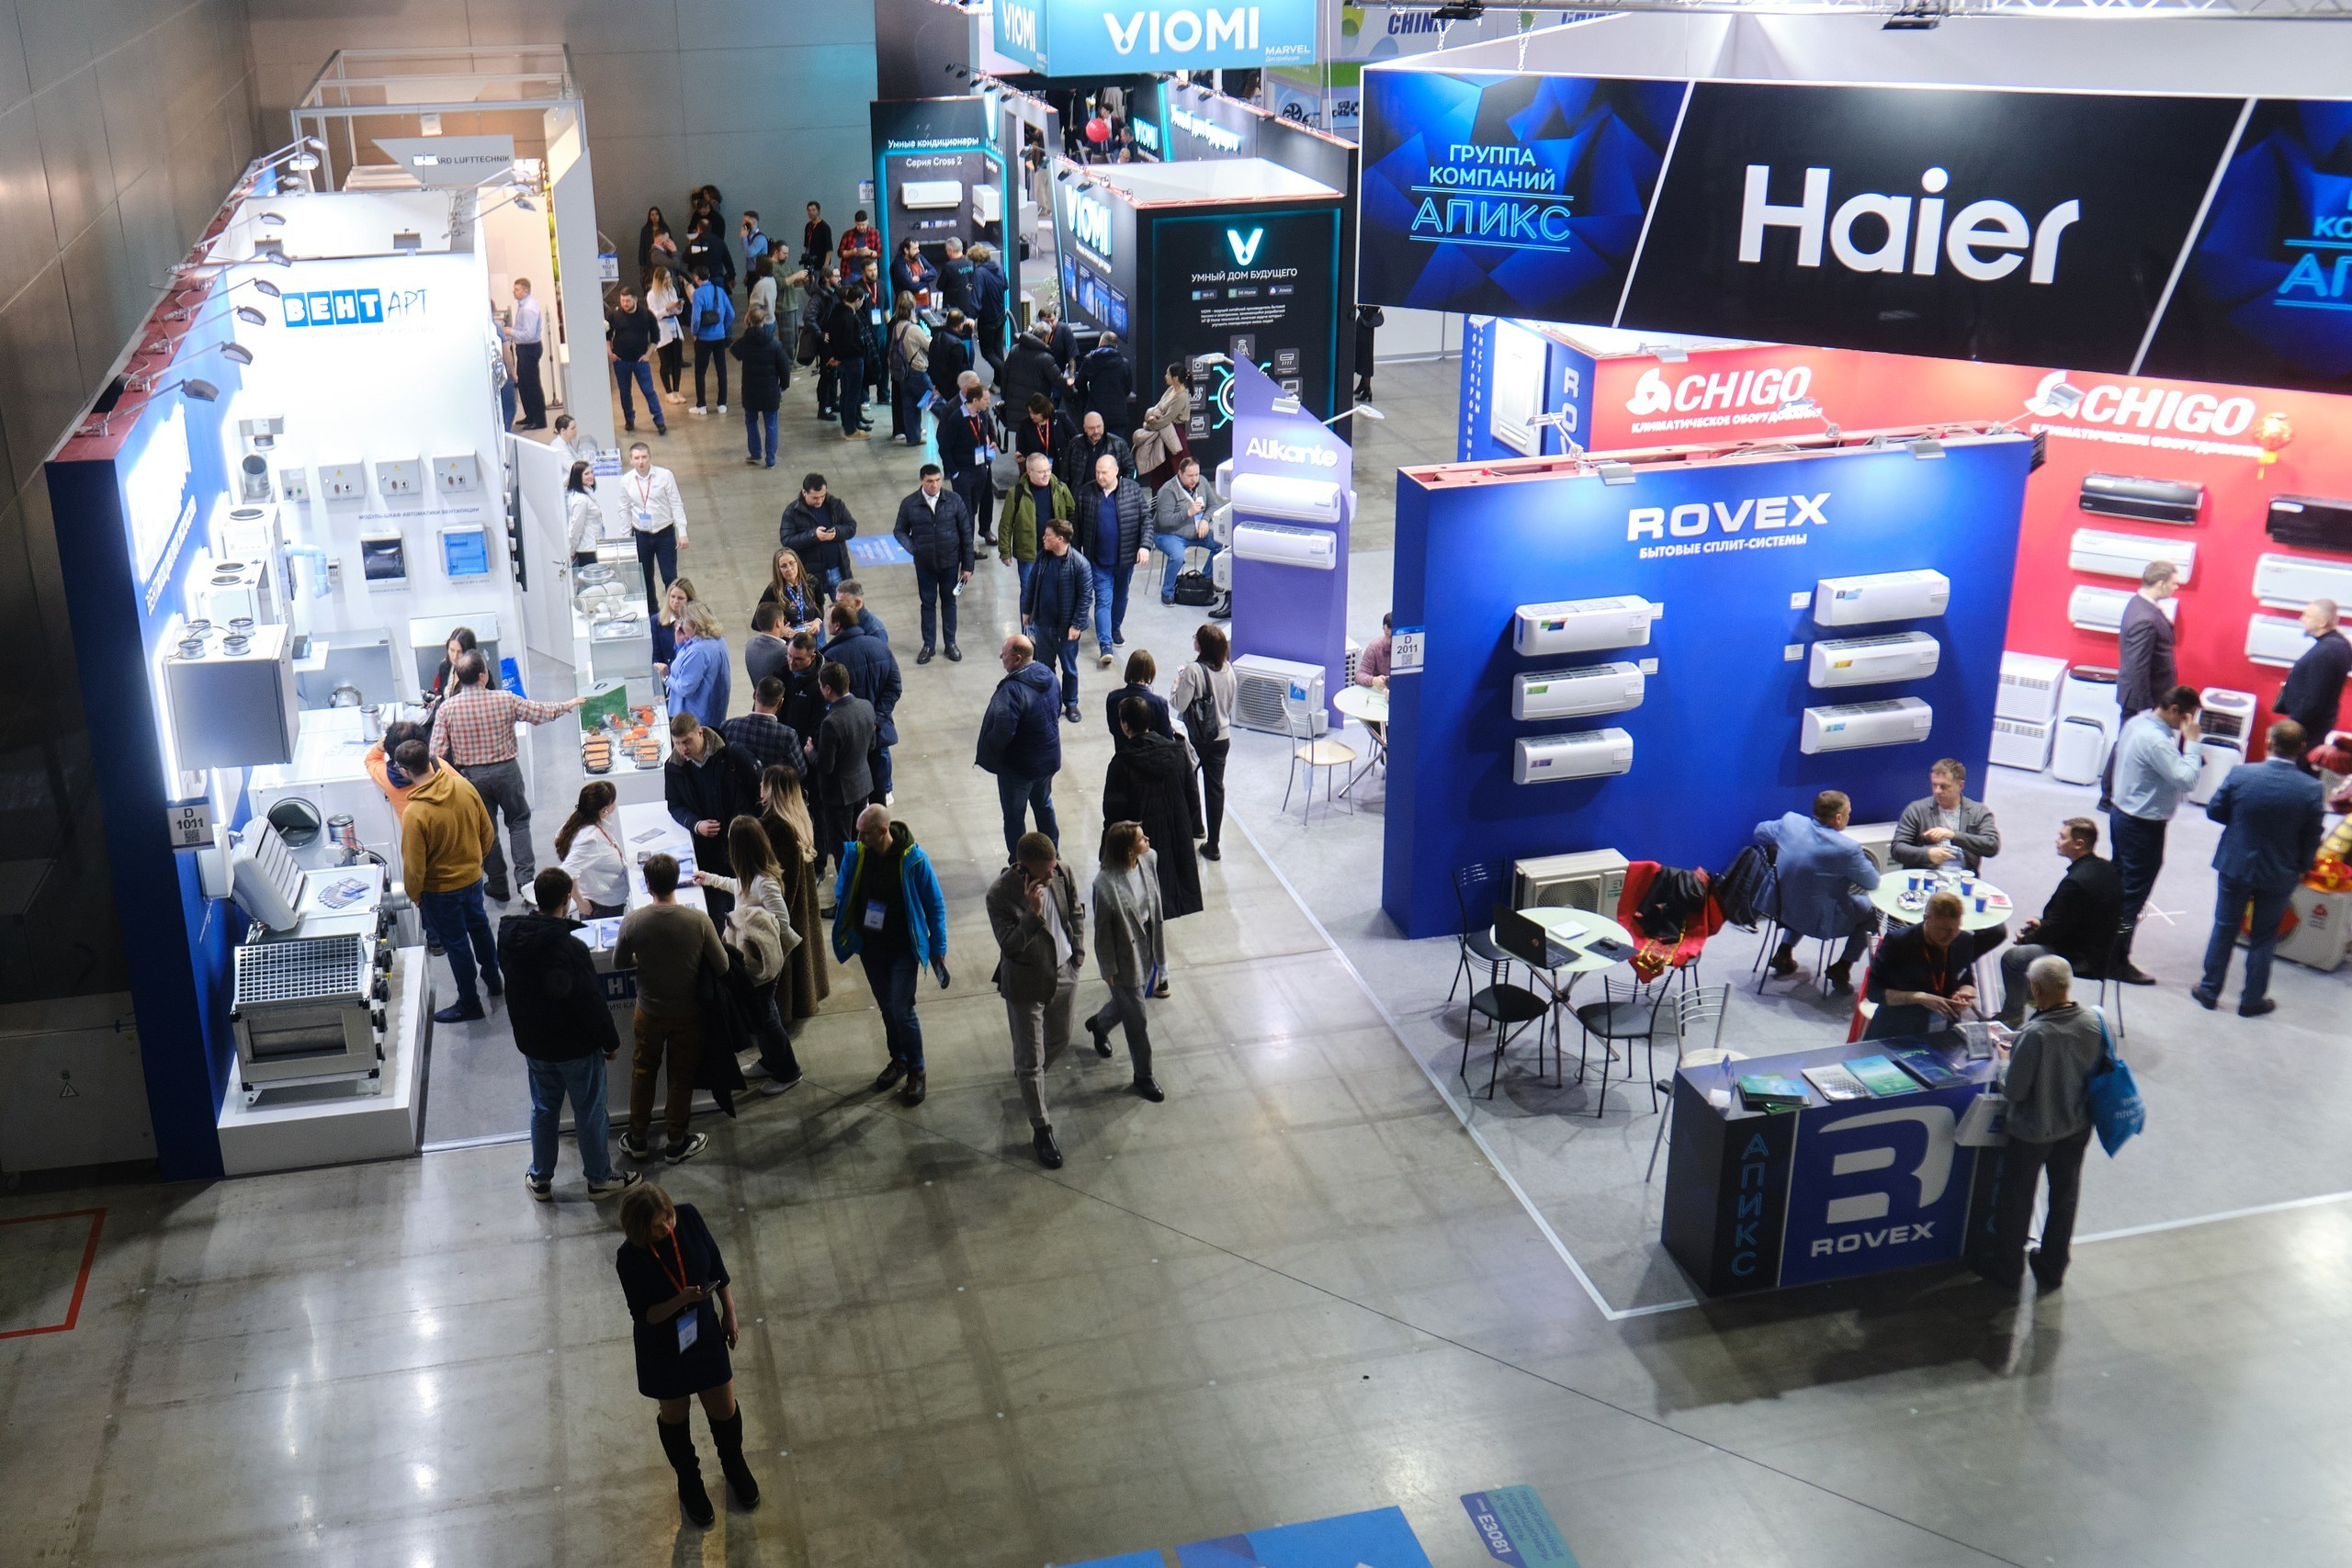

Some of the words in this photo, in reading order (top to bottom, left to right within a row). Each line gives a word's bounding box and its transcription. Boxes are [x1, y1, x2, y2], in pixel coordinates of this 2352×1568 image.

[1002, 0, 1036, 52] VIOMI
[1103, 6, 1260, 55] VIOMI
[1265, 45, 1312, 55] MARVEL
[888, 139, 916, 150] Умные
[917, 137, 979, 148] кондиционеры
[1449, 144, 1536, 167] ГРУППА
[454, 154, 511, 164] LUFTTECHNIK
[906, 157, 932, 168] Серия
[933, 156, 956, 166] Cross
[956, 155, 963, 165] 2
[1429, 165, 1556, 192] КОМПАНИЙ
[1065, 184, 1113, 257] VIOMI
[1411, 196, 1571, 242] АПИКС
[1738, 164, 2080, 285] Haier
[1192, 270, 1226, 282] УМНЫЙ
[1227, 270, 1249, 282] ДОМ
[1250, 268, 1298, 279] БУДУЩЕГО
[283, 291, 381, 324] ВЕНТ
[1674, 366, 1813, 412] CHIGO
[1632, 414, 1731, 434] КЛИМАТИЧЕСКОЕ
[2081, 385, 2256, 436] CHIGO
[1626, 492, 1832, 542] ROVEX
[1639, 542, 1702, 559] БЫТОВЫЕ
[1702, 533, 1808, 553] СПЛИТ-СИСТЕМЫ
[1396, 644, 1418, 654] 2011
[1404, 635, 1412, 644] D
[176, 818, 204, 830] 1011
[184, 807, 194, 818] D
[1731, 1133, 1770, 1277] АПИКС
[1810, 1221, 1937, 1258] ROVEX
[1477, 1514, 1512, 1554] E3081
